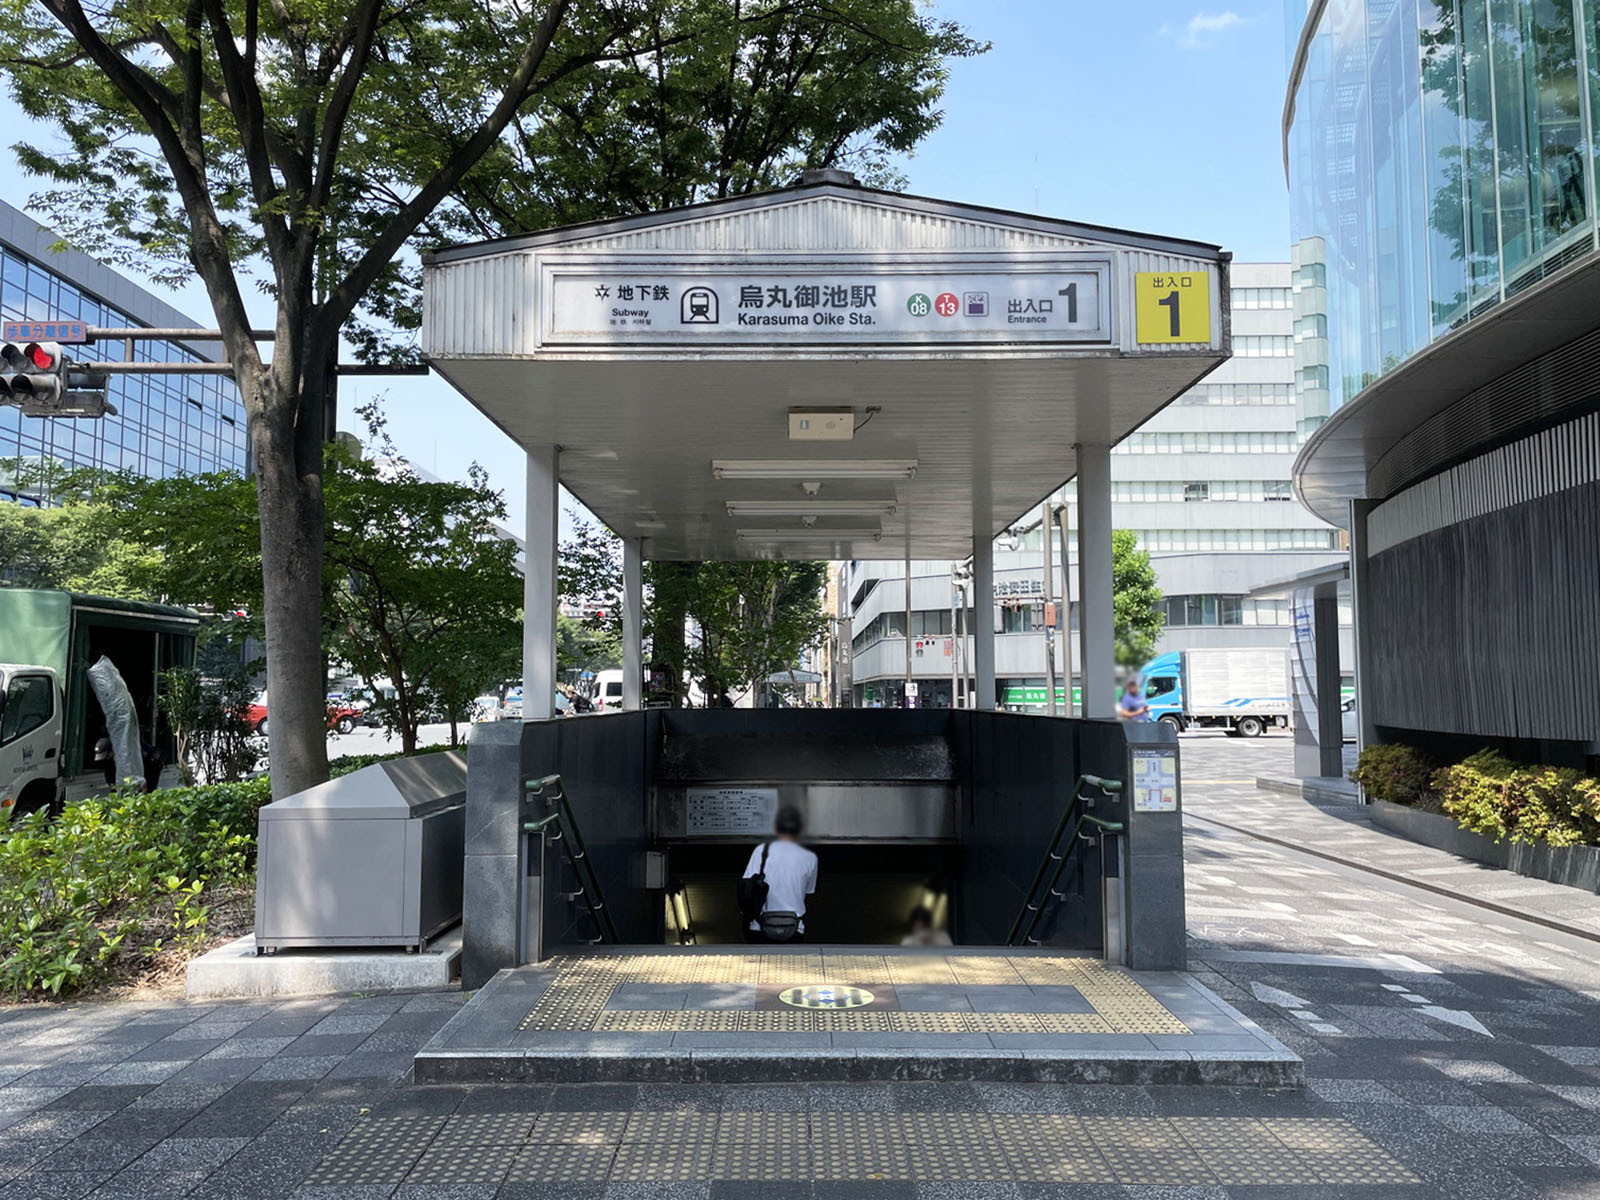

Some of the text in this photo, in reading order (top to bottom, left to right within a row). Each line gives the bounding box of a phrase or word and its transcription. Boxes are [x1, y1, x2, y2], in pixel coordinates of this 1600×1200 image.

[1153, 276, 1192, 288] 出入口
[617, 284, 670, 301] 地下鉄
[738, 285, 877, 309] 烏丸御池駅
[915, 295, 923, 303] K
[943, 295, 950, 303] T
[1058, 283, 1077, 323] 1
[910, 303, 928, 315] 08
[938, 303, 956, 315] 13
[1008, 299, 1053, 314] 出入口
[612, 308, 649, 318] Subway
[738, 312, 876, 326] Karasuma Oike Sta.
[1158, 291, 1181, 337] 1
[1008, 315, 1048, 324] Entrance
